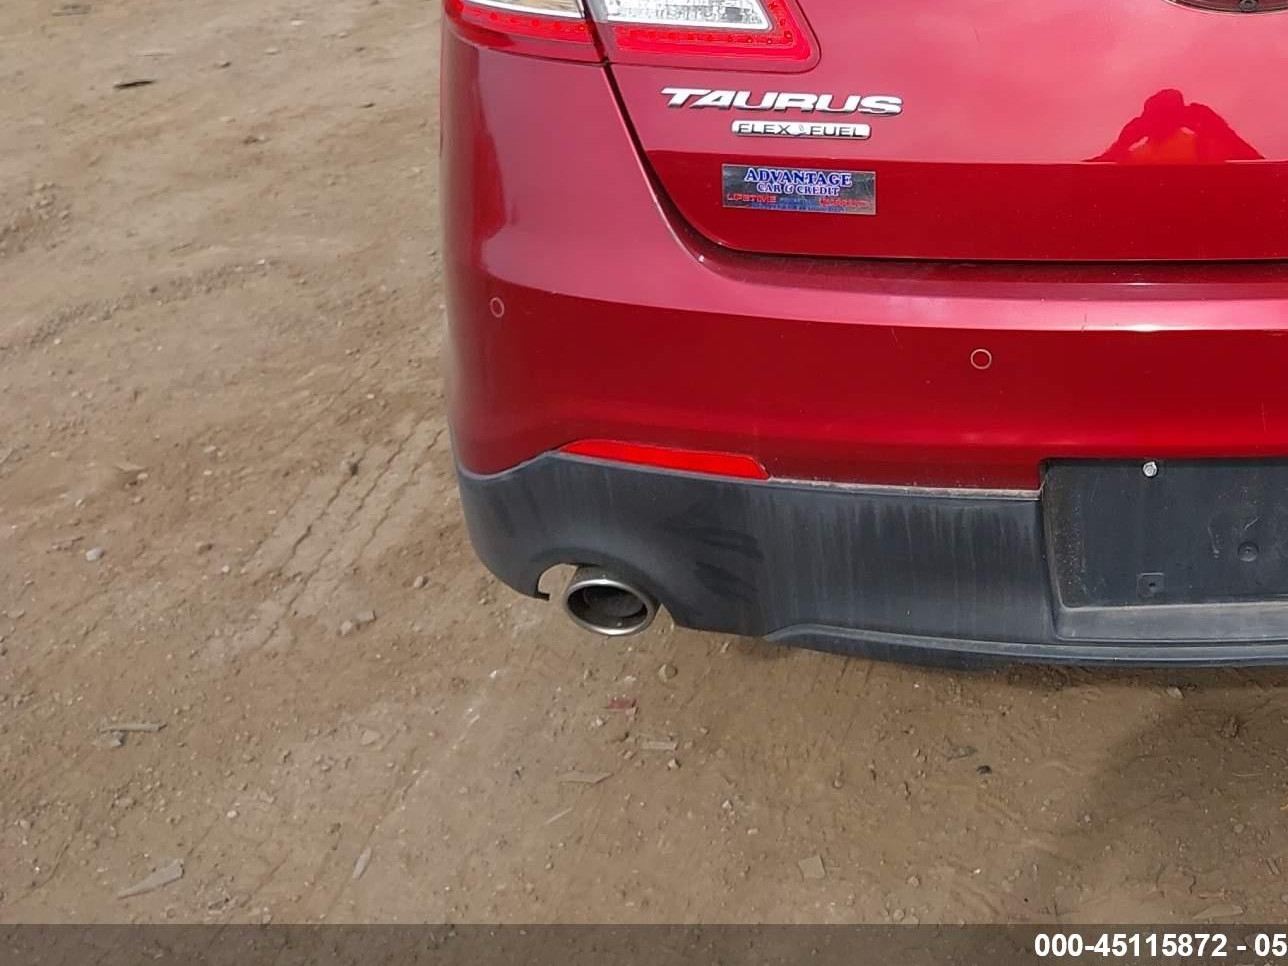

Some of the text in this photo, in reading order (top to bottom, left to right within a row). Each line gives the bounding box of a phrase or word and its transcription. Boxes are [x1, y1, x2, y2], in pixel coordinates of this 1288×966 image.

[660, 87, 903, 115] TAURUS
[737, 122, 864, 138] FLEX FUEL
[744, 167, 852, 187] ADVANTAGE
[757, 183, 840, 196] CAR & CREDIT
